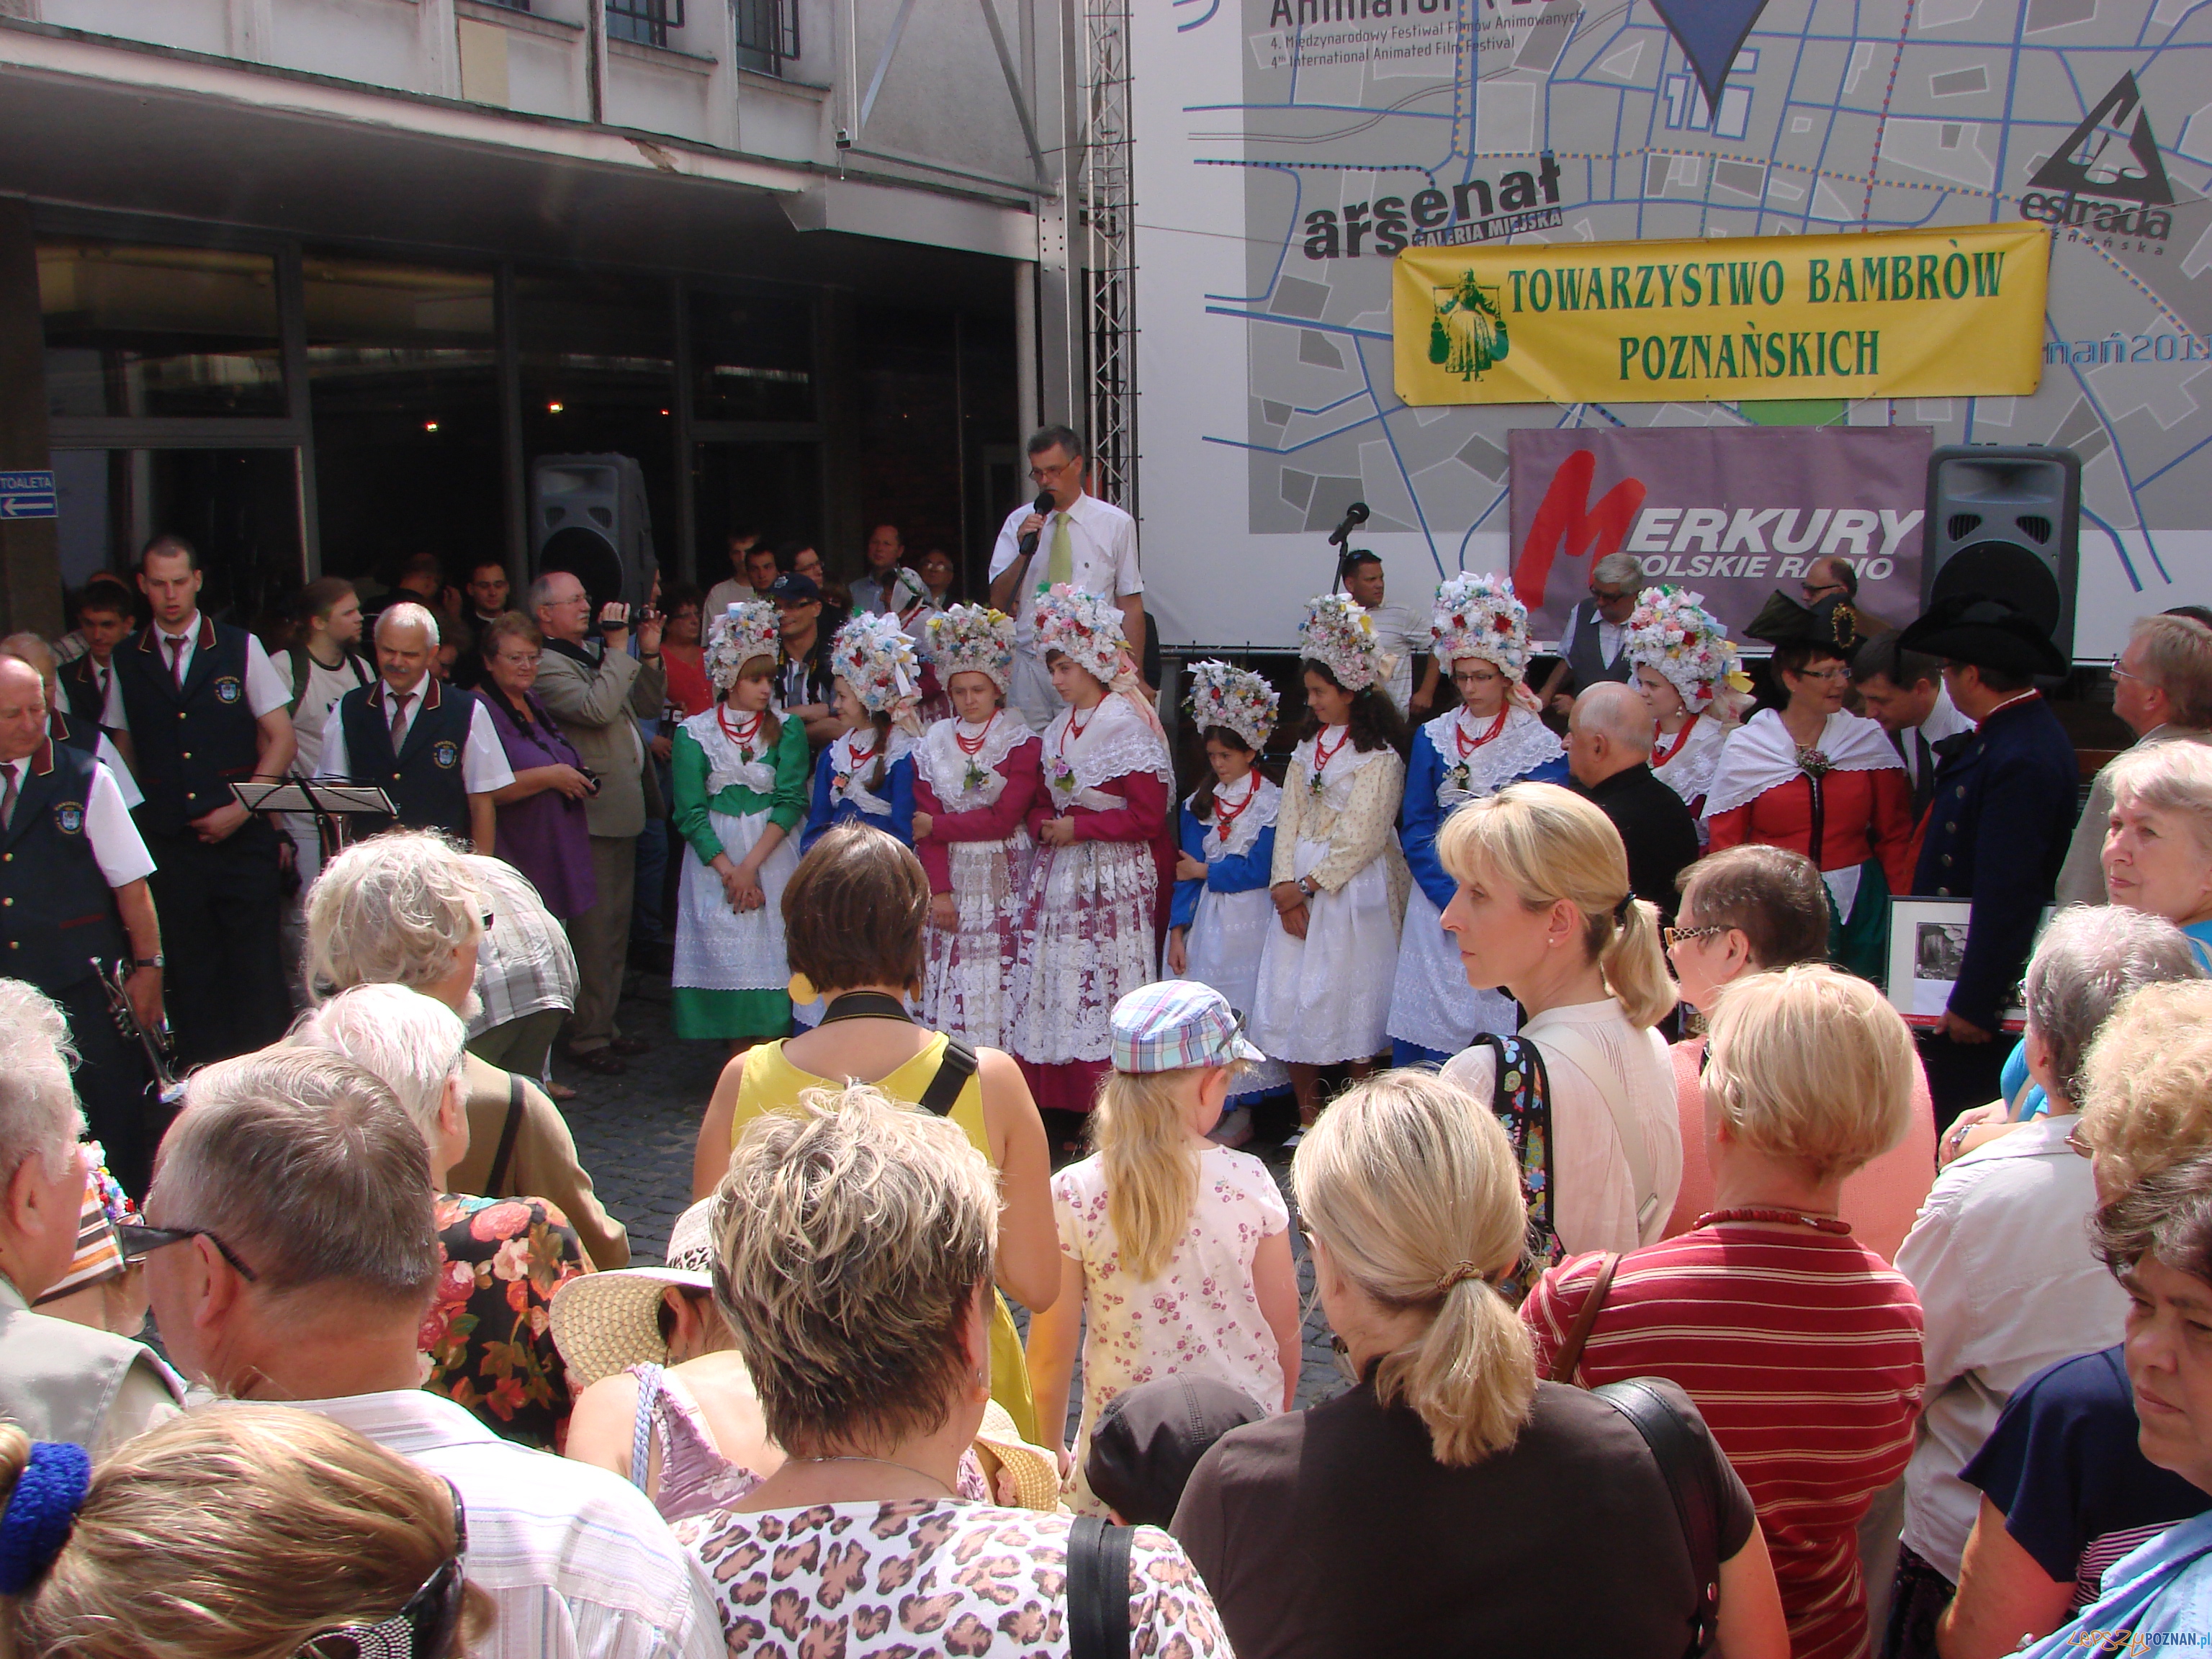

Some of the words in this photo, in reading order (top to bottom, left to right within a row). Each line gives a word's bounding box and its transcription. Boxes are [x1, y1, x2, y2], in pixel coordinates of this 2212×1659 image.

[1271, 37, 1282, 50] 4.
[1285, 30, 1388, 51] Międzynarodowy
[1391, 22, 1443, 40] Festiwal
[1290, 48, 1369, 67] International
[1373, 43, 1432, 60] Animated
[1437, 41, 1465, 55] Film
[1466, 35, 1515, 53] Festival
[1414, 224, 1483, 247] GALERIA
[1487, 207, 1563, 238] MIEJSKA
[2019, 192, 2172, 241] estrada
[1507, 260, 1784, 313] TOWARZYSTWO
[1, 477, 52, 489] TOALETA
[1629, 554, 1771, 579] OLSKIE
[1775, 556, 1894, 580] RIO
